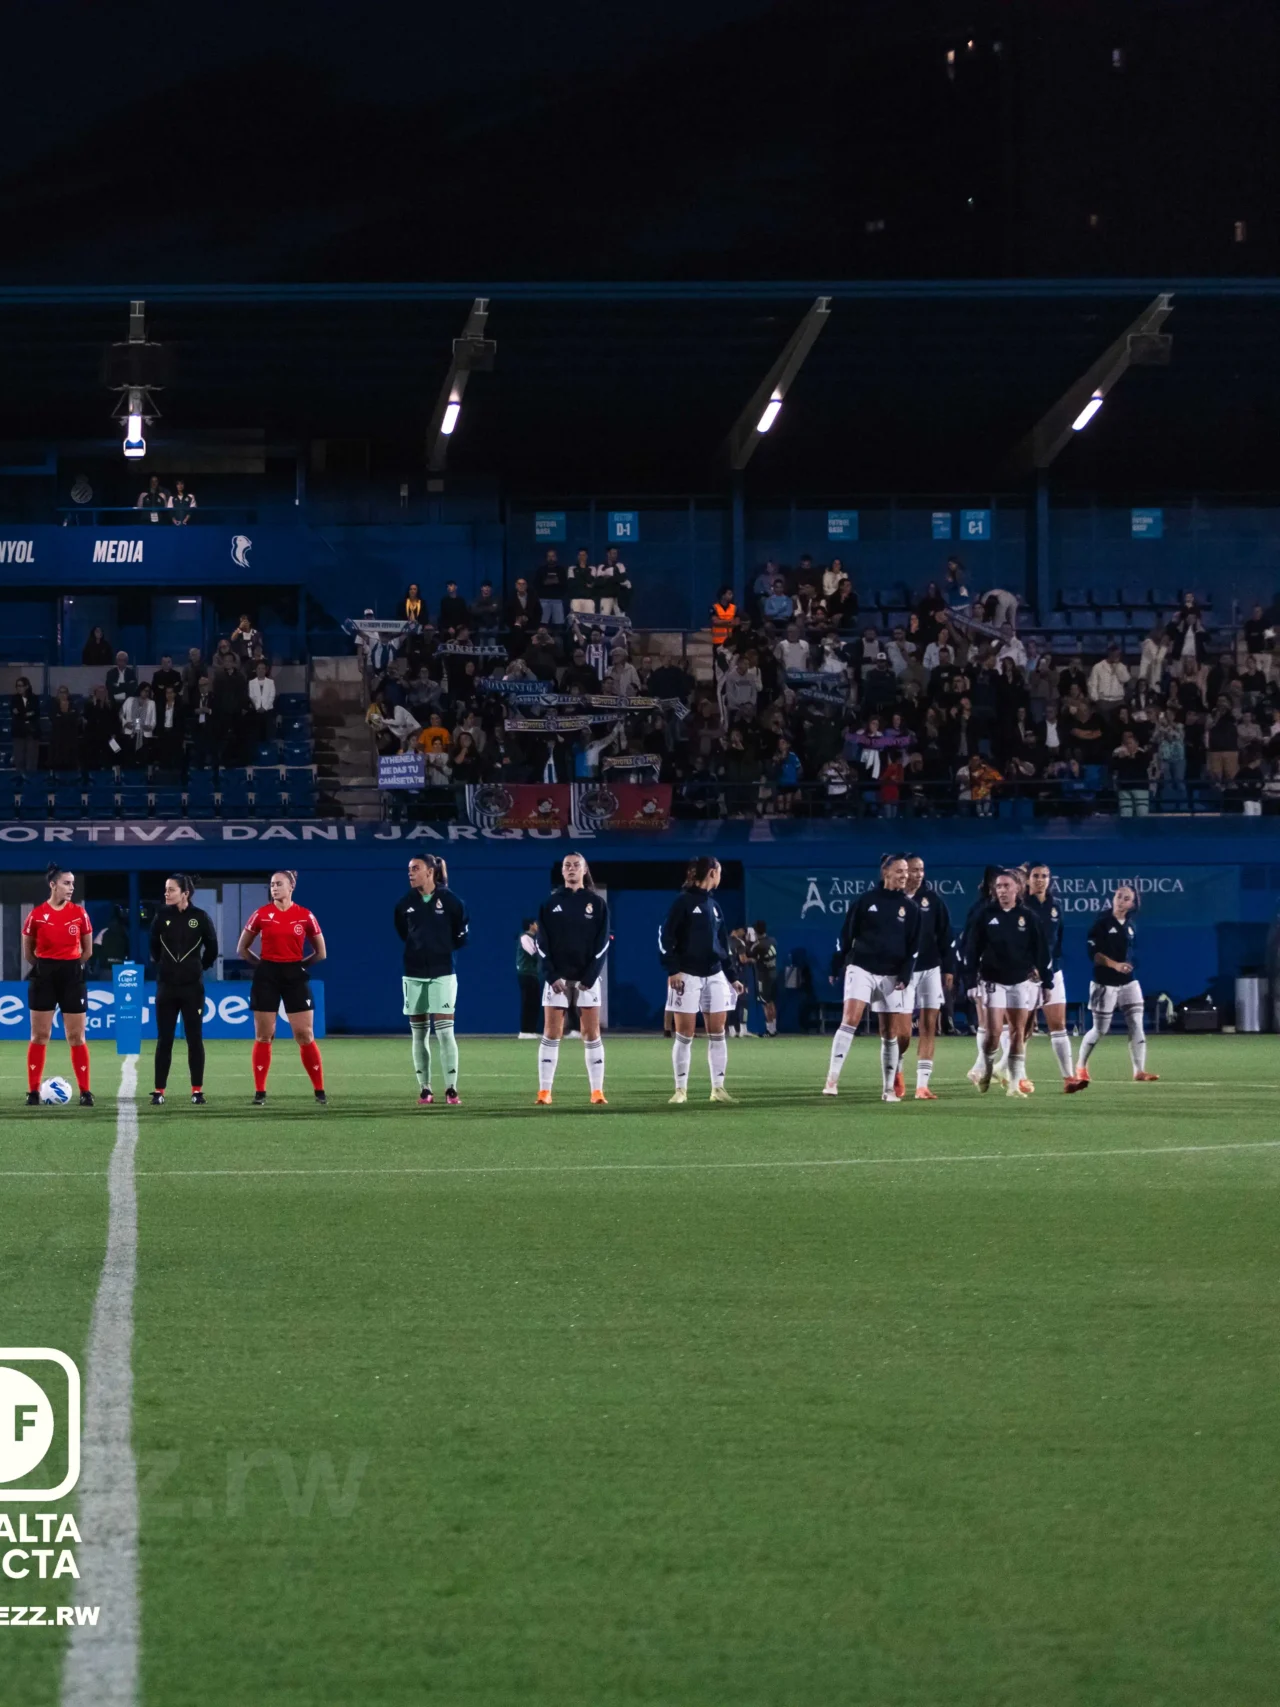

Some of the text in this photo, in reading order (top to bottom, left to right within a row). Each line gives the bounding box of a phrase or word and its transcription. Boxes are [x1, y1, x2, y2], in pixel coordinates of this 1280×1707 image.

[616, 522, 631, 536] D-1
[968, 520, 983, 535] C-1
[92, 540, 144, 562] MEDIA
[221, 824, 357, 840] DANI
[373, 824, 597, 840] JARQUE
[1100, 875, 1184, 896] JURÍDICA
[106, 1014, 116, 1028] F
